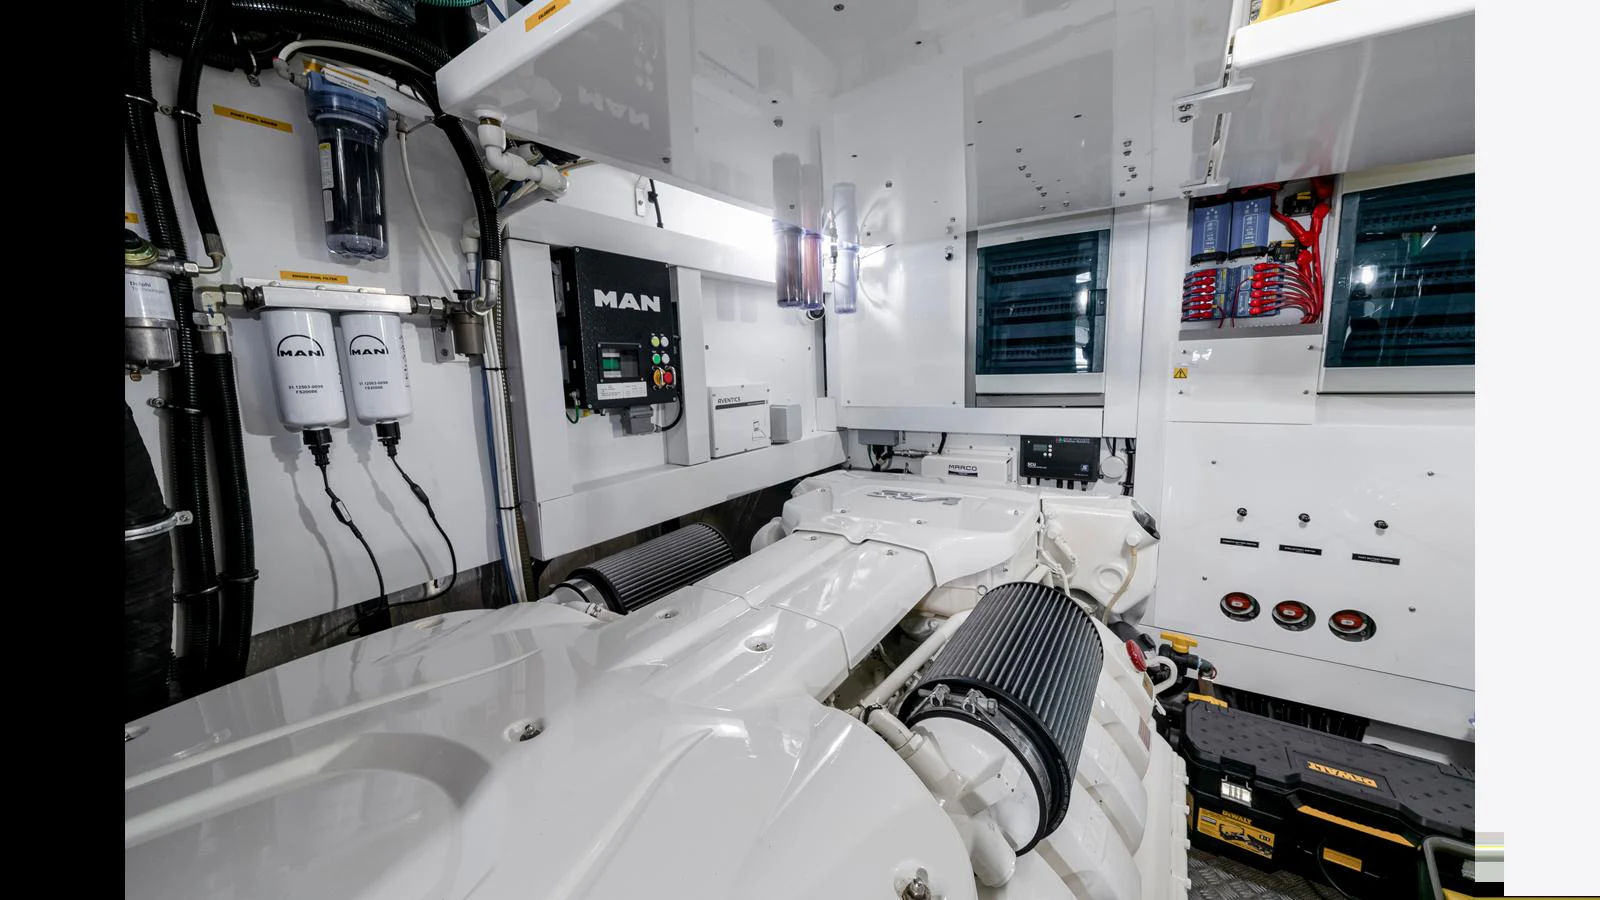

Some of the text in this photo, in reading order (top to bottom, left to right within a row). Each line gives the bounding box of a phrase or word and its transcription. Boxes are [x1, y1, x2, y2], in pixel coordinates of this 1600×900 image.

[593, 288, 661, 313] MAN
[351, 348, 386, 356] MAN
[1306, 760, 1378, 789] DEWALT
